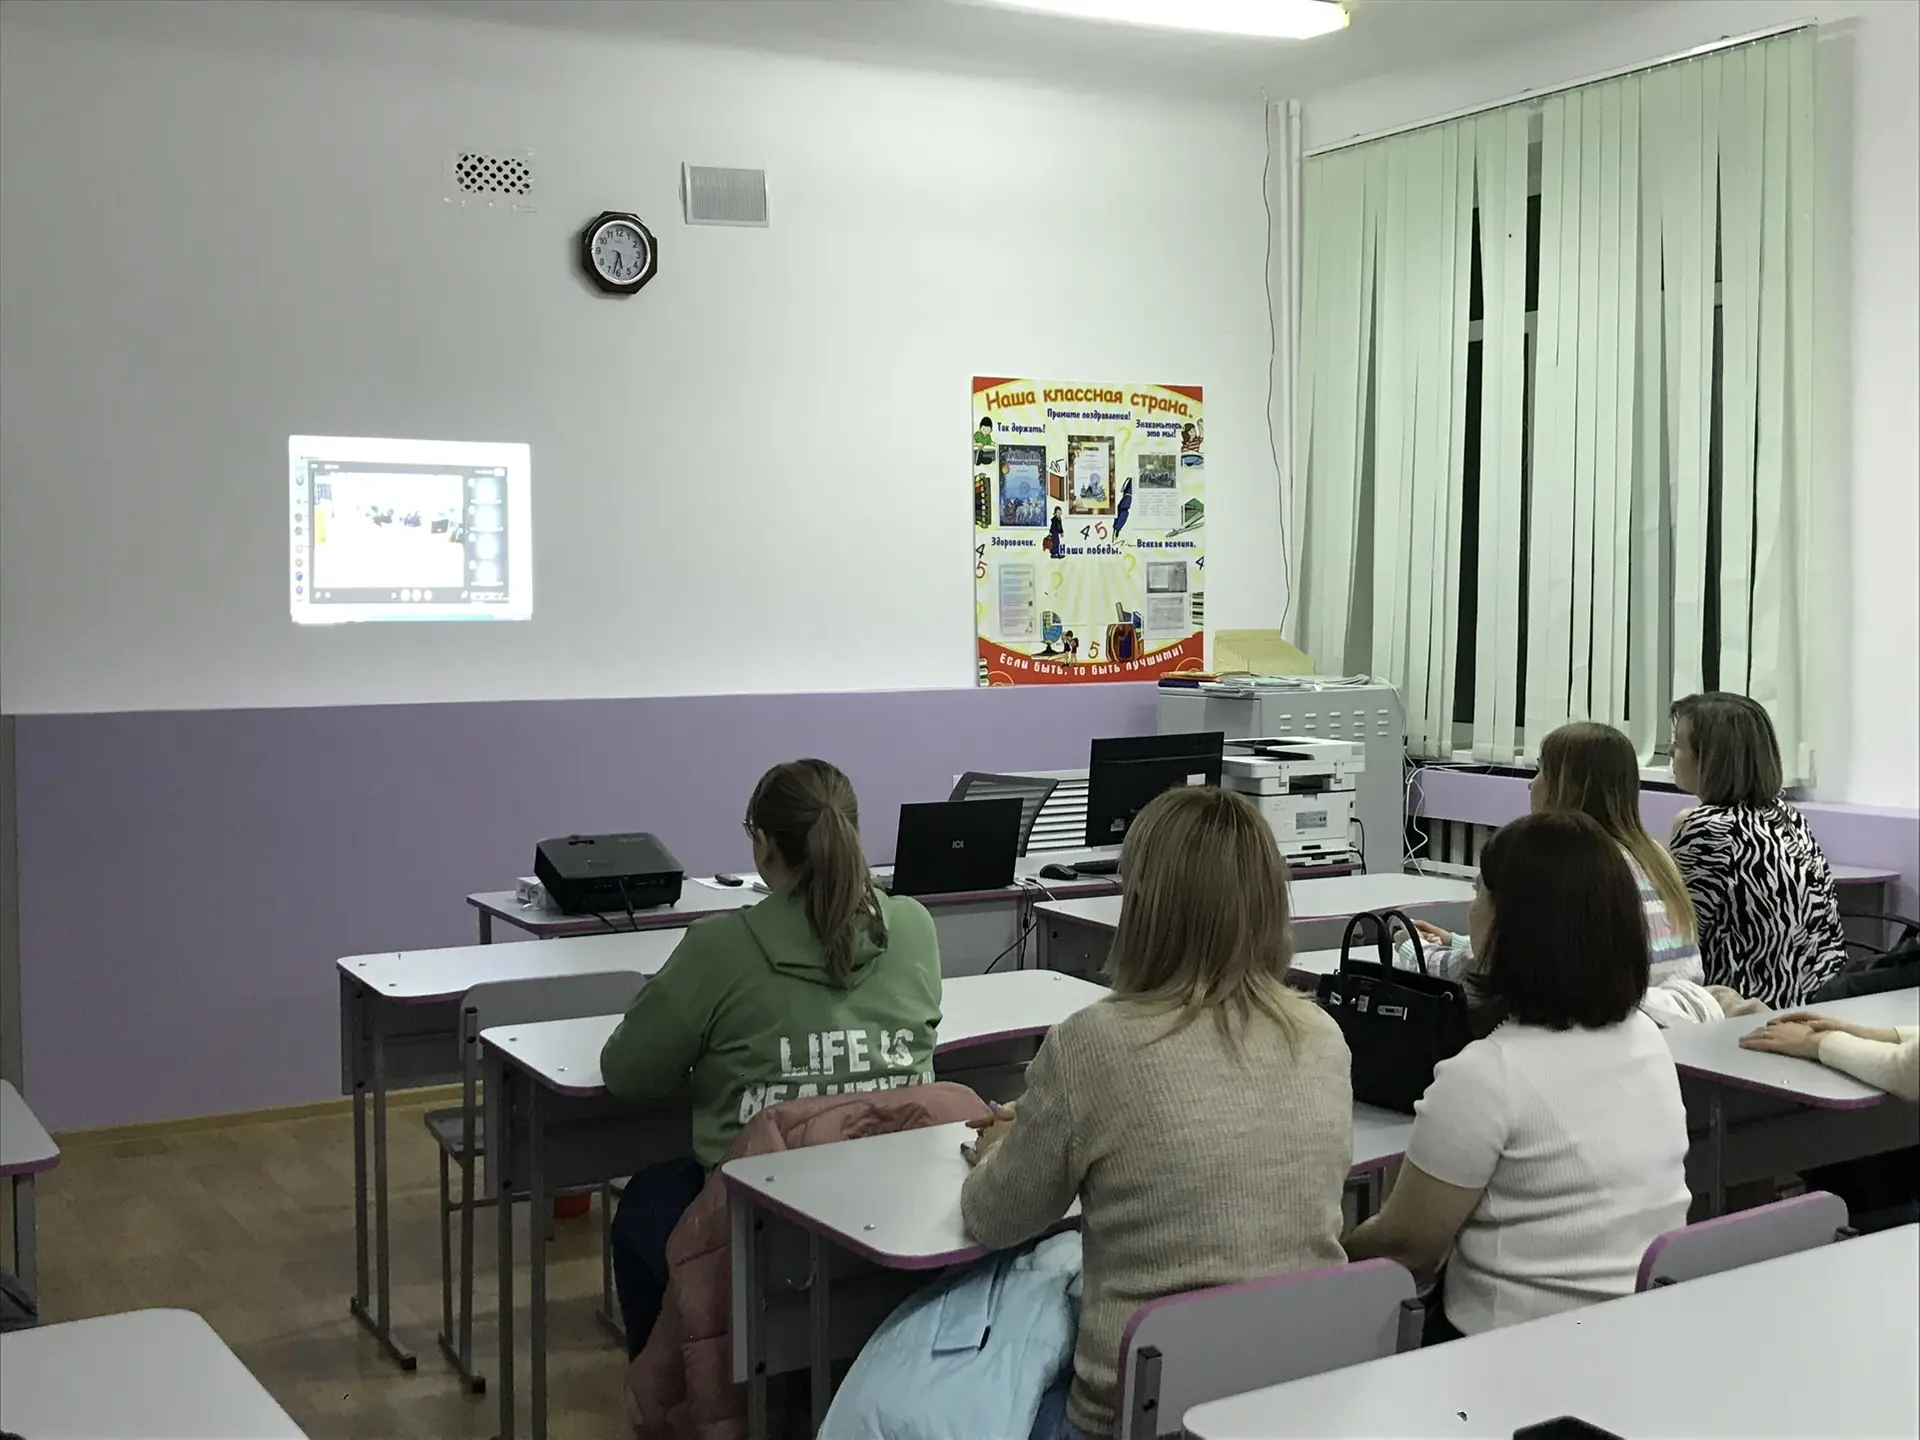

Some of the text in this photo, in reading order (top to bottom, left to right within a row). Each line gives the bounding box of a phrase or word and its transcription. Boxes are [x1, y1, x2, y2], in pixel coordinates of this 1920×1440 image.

[607, 230, 613, 239] 11
[615, 228, 624, 237] 12
[600, 237, 607, 245] 10
[985, 388, 1193, 418] Наша классная страна.
[1047, 408, 1131, 422] Примите поздравления!
[997, 422, 1046, 434] Так держать!
[1147, 429, 1176, 438] это мы!
[1080, 521, 1108, 540] 4 5
[991, 537, 1036, 549] Здоровячок.
[1060, 543, 1122, 555] Наши победы.
[1137, 538, 1196, 548] Всякая всячина.
[975, 543, 986, 559] 4
[975, 560, 987, 579] 5
[1088, 641, 1100, 659] 5
[780, 1028, 914, 1077] LIFE IS
